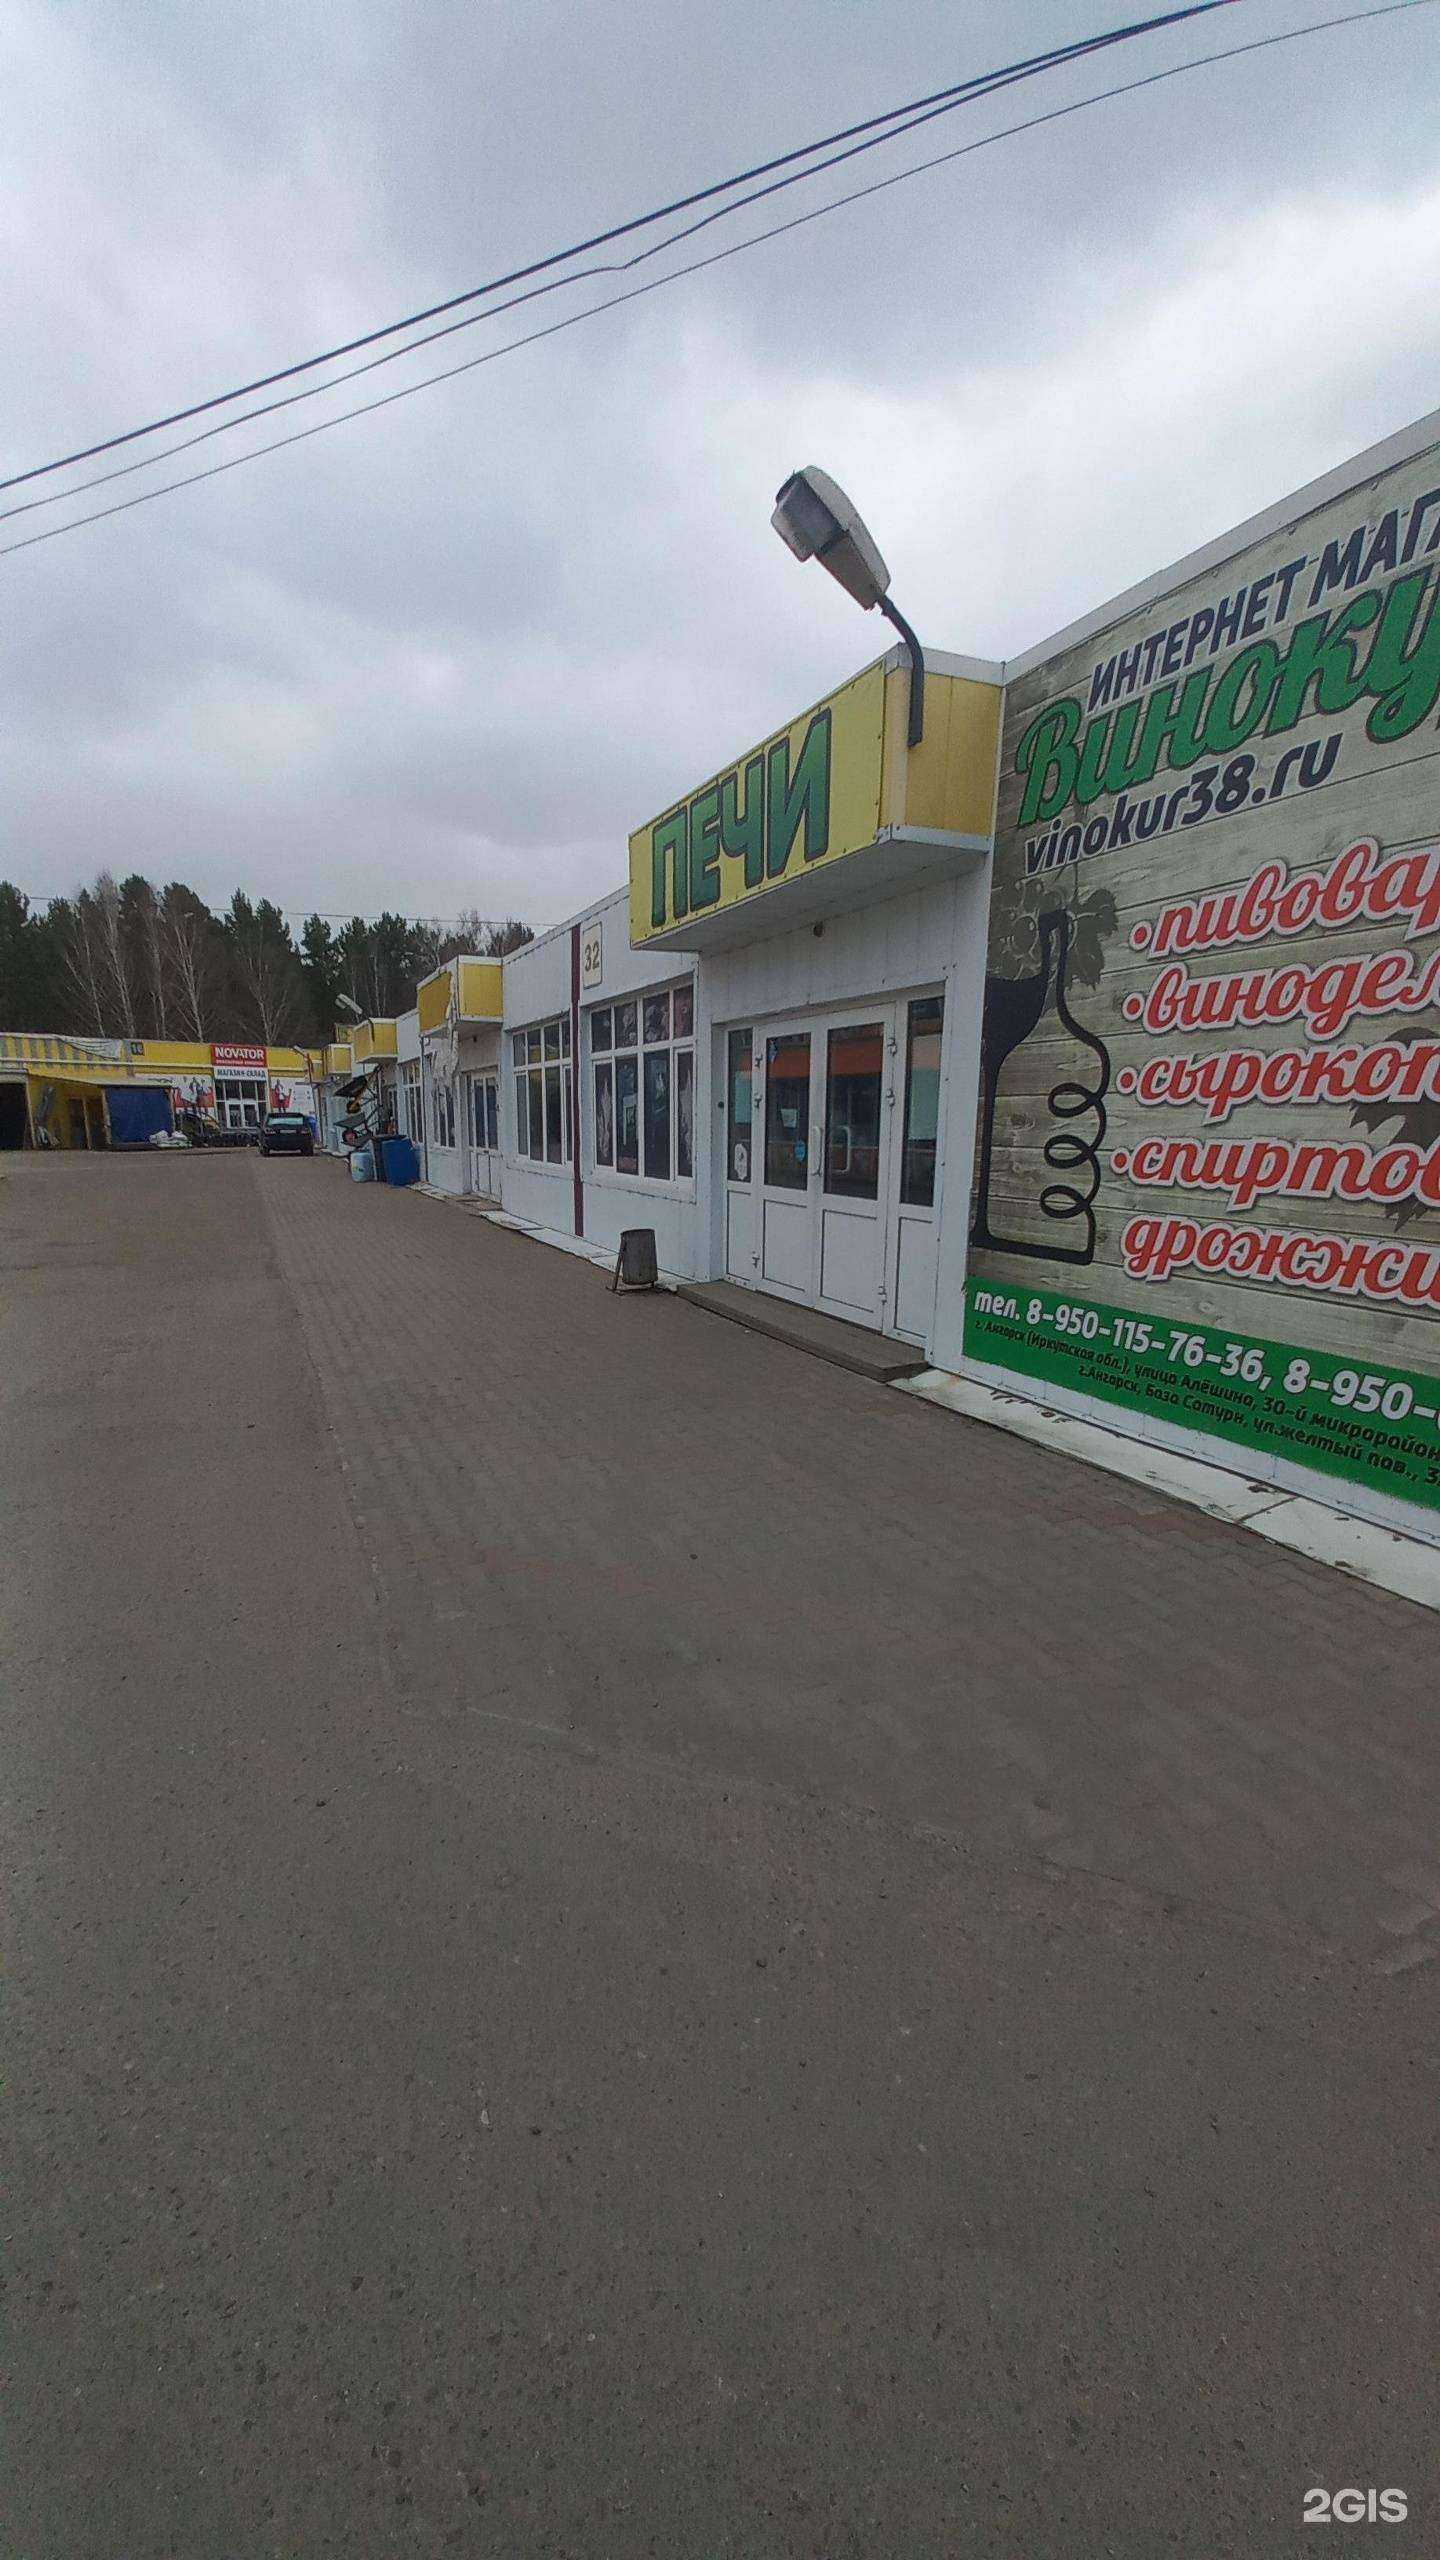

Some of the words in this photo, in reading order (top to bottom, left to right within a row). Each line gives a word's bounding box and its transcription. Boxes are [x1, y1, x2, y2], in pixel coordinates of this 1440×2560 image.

[1014, 564, 1440, 827] Виноку
[1087, 555, 1306, 713] ИНТЕРНЕТ
[651, 706, 832, 928] ПЕЧИ
[1025, 733, 1343, 875] vinokur38.ru
[585, 940, 600, 972] 32
[215, 1046, 264, 1060] NOVATOR
[974, 1290, 1020, 1321] тел.
[1025, 1298, 1272, 1392] 8-950-115-76-36,
[1282, 1358, 1440, 1431] 8-950-
[1134, 1364, 1177, 1386] улица
[1261, 1396, 1308, 1422] 30-й
[1145, 1382, 1180, 1406] База
